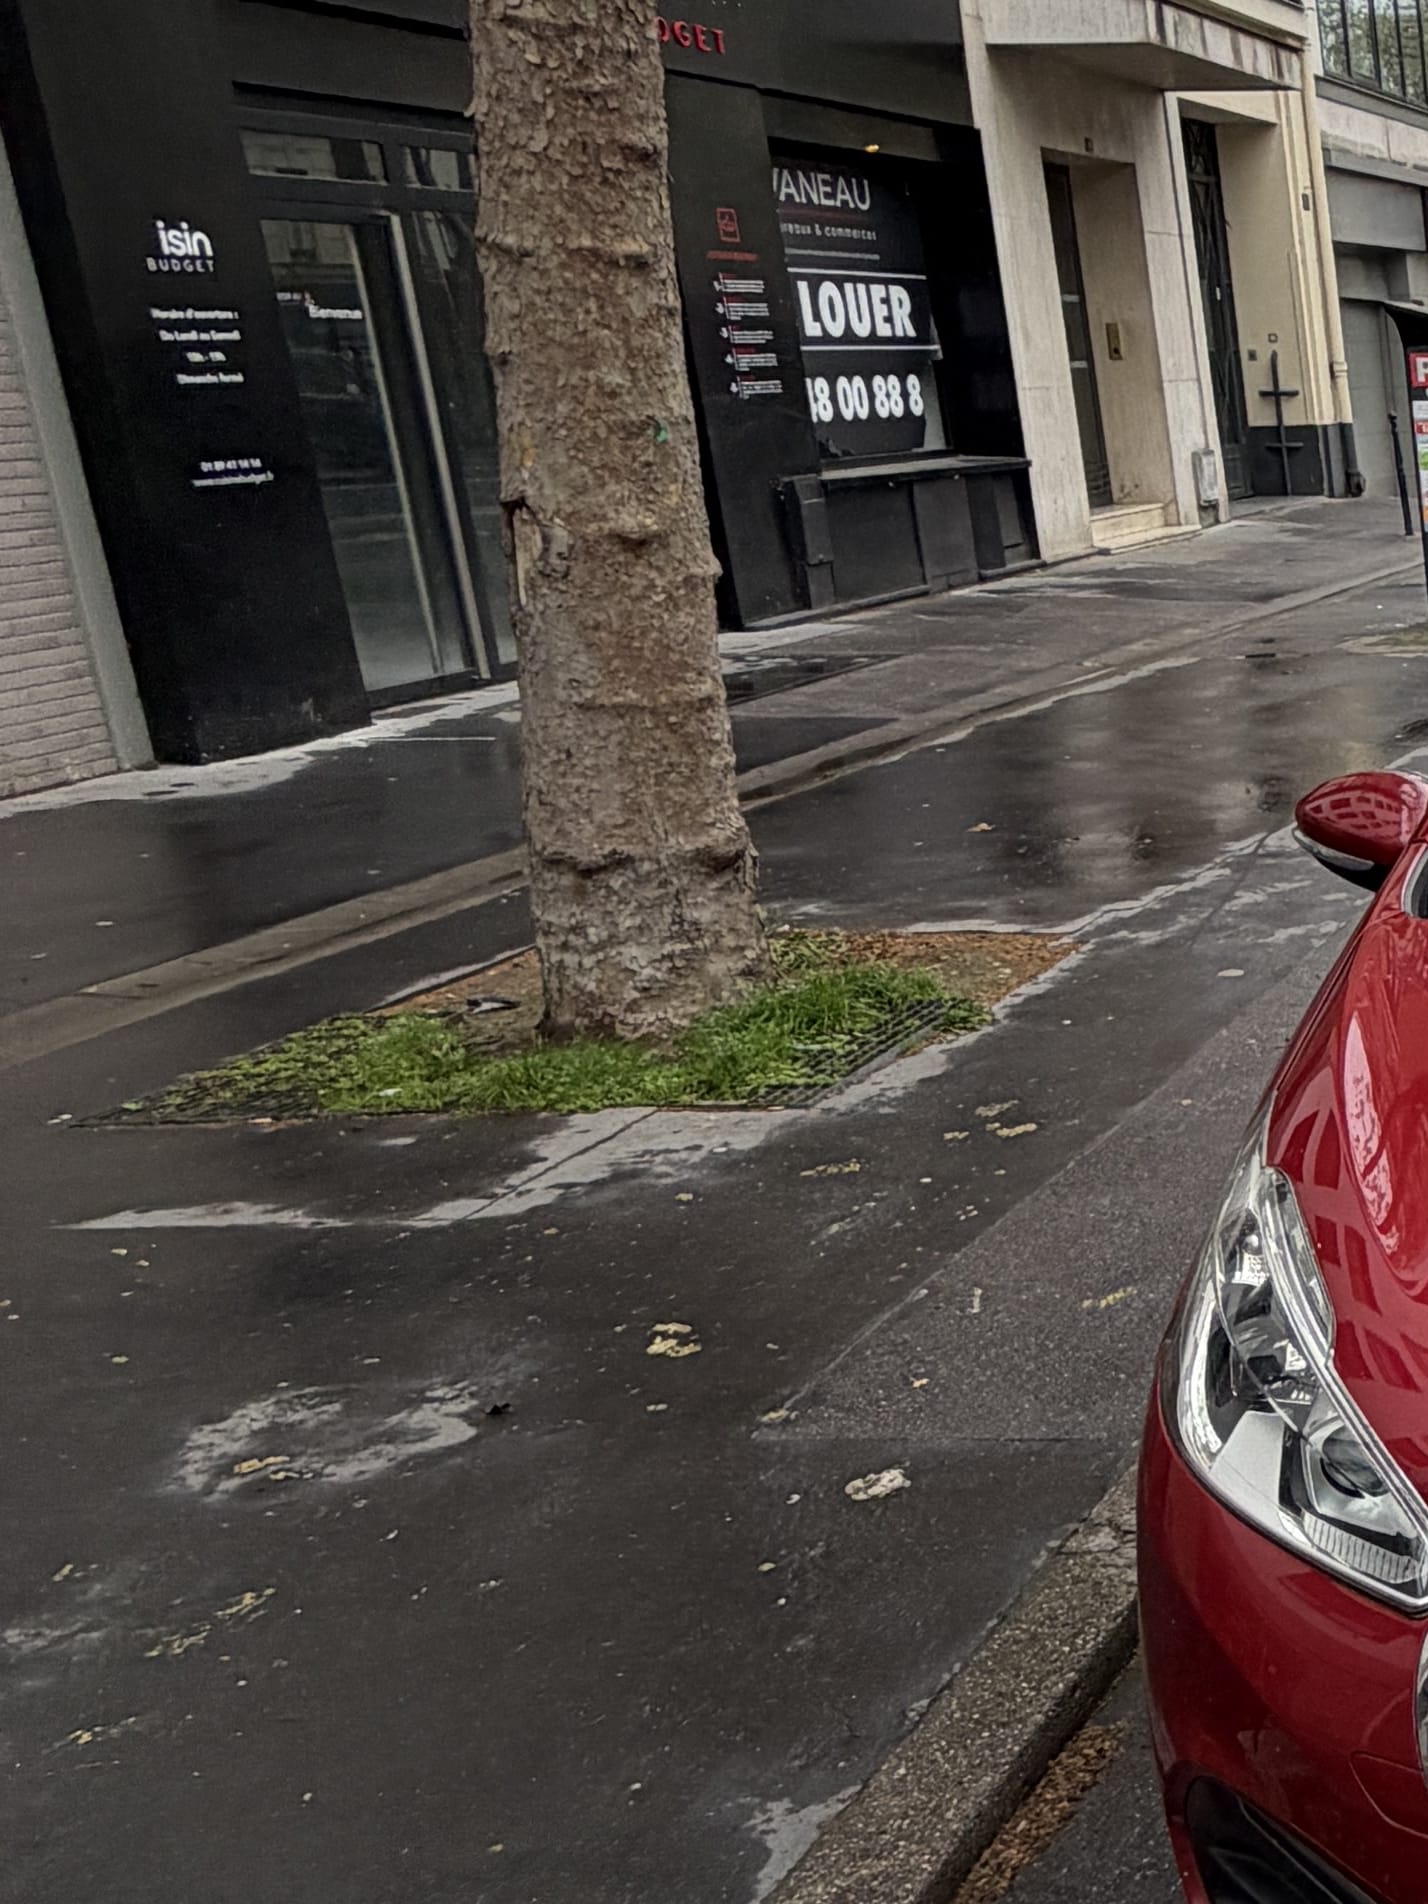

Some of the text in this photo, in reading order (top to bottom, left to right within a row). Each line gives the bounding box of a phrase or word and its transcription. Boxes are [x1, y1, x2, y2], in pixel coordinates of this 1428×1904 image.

[146, 257, 215, 273] BUDGET
[797, 280, 917, 338] LOUER
[836, 375, 869, 422] 00
[872, 373, 904, 419] 88
[906, 373, 924, 417] 8
